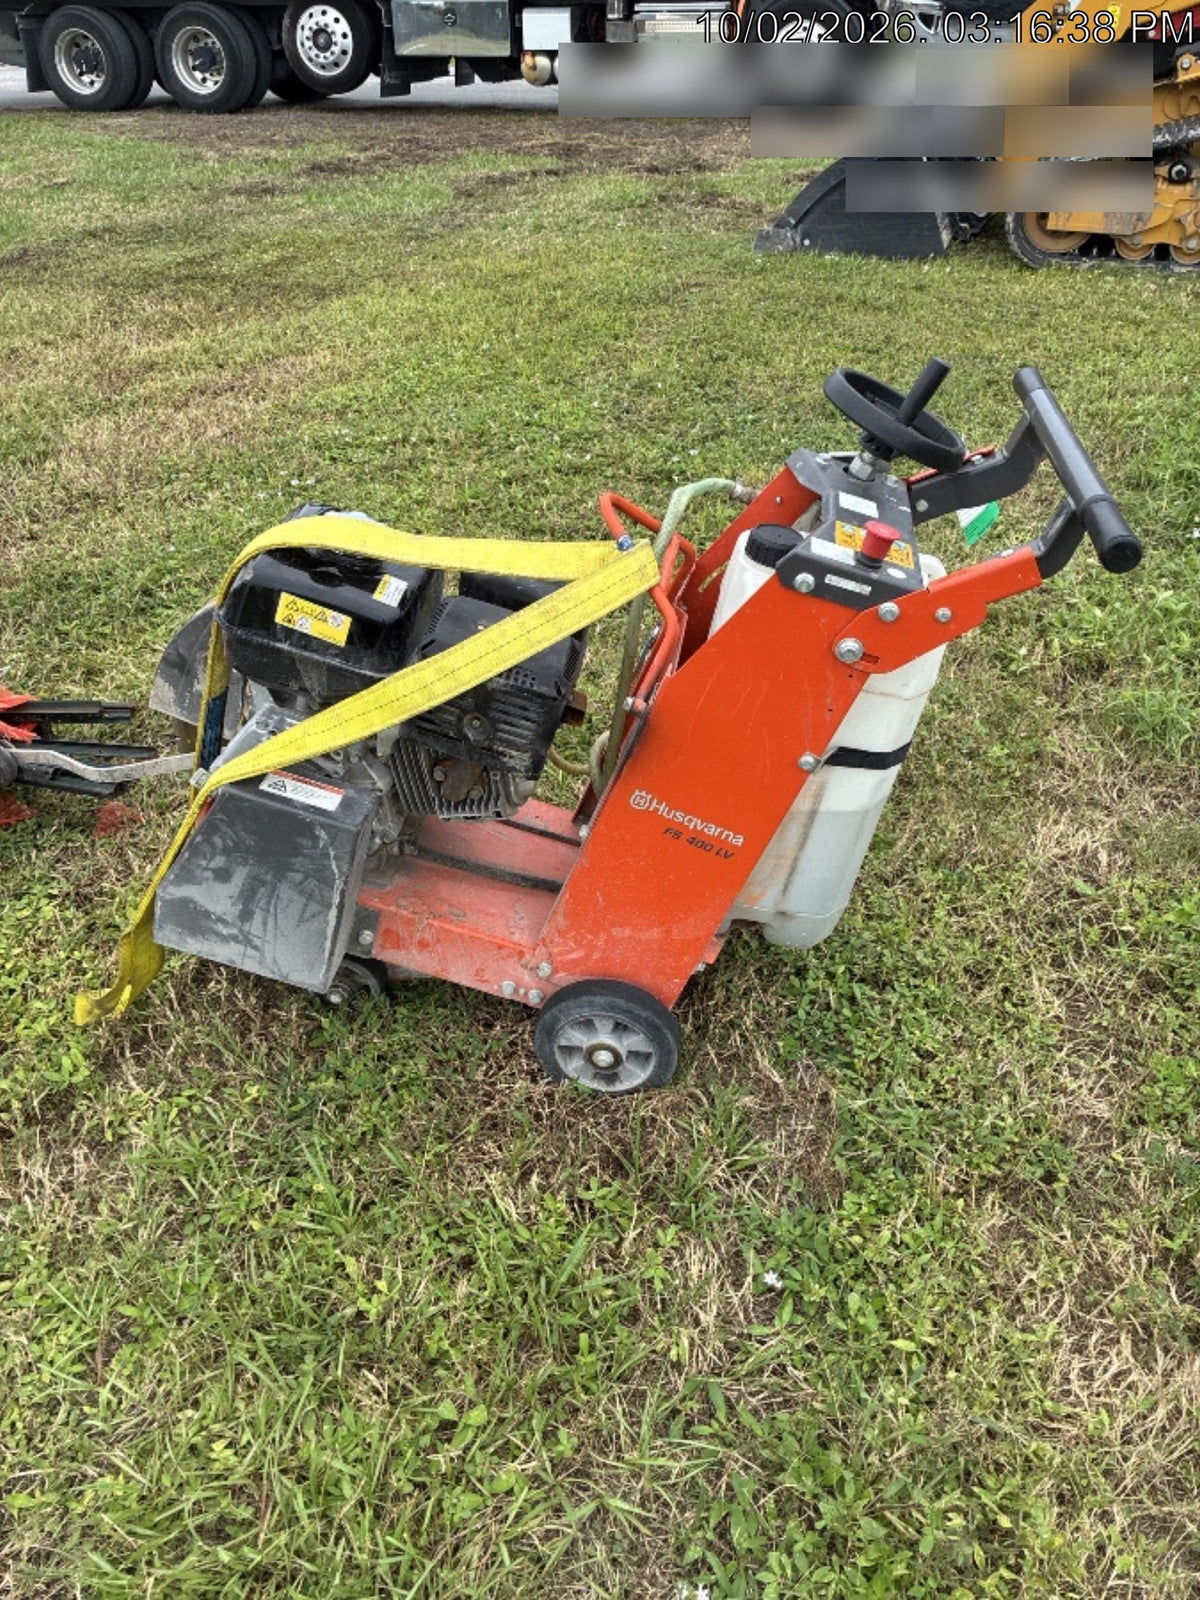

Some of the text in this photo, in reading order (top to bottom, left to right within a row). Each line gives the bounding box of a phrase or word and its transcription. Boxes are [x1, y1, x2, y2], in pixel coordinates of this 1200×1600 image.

[651, 798, 745, 846] Husqvarna
[664, 828, 735, 859] FS 400 LV
